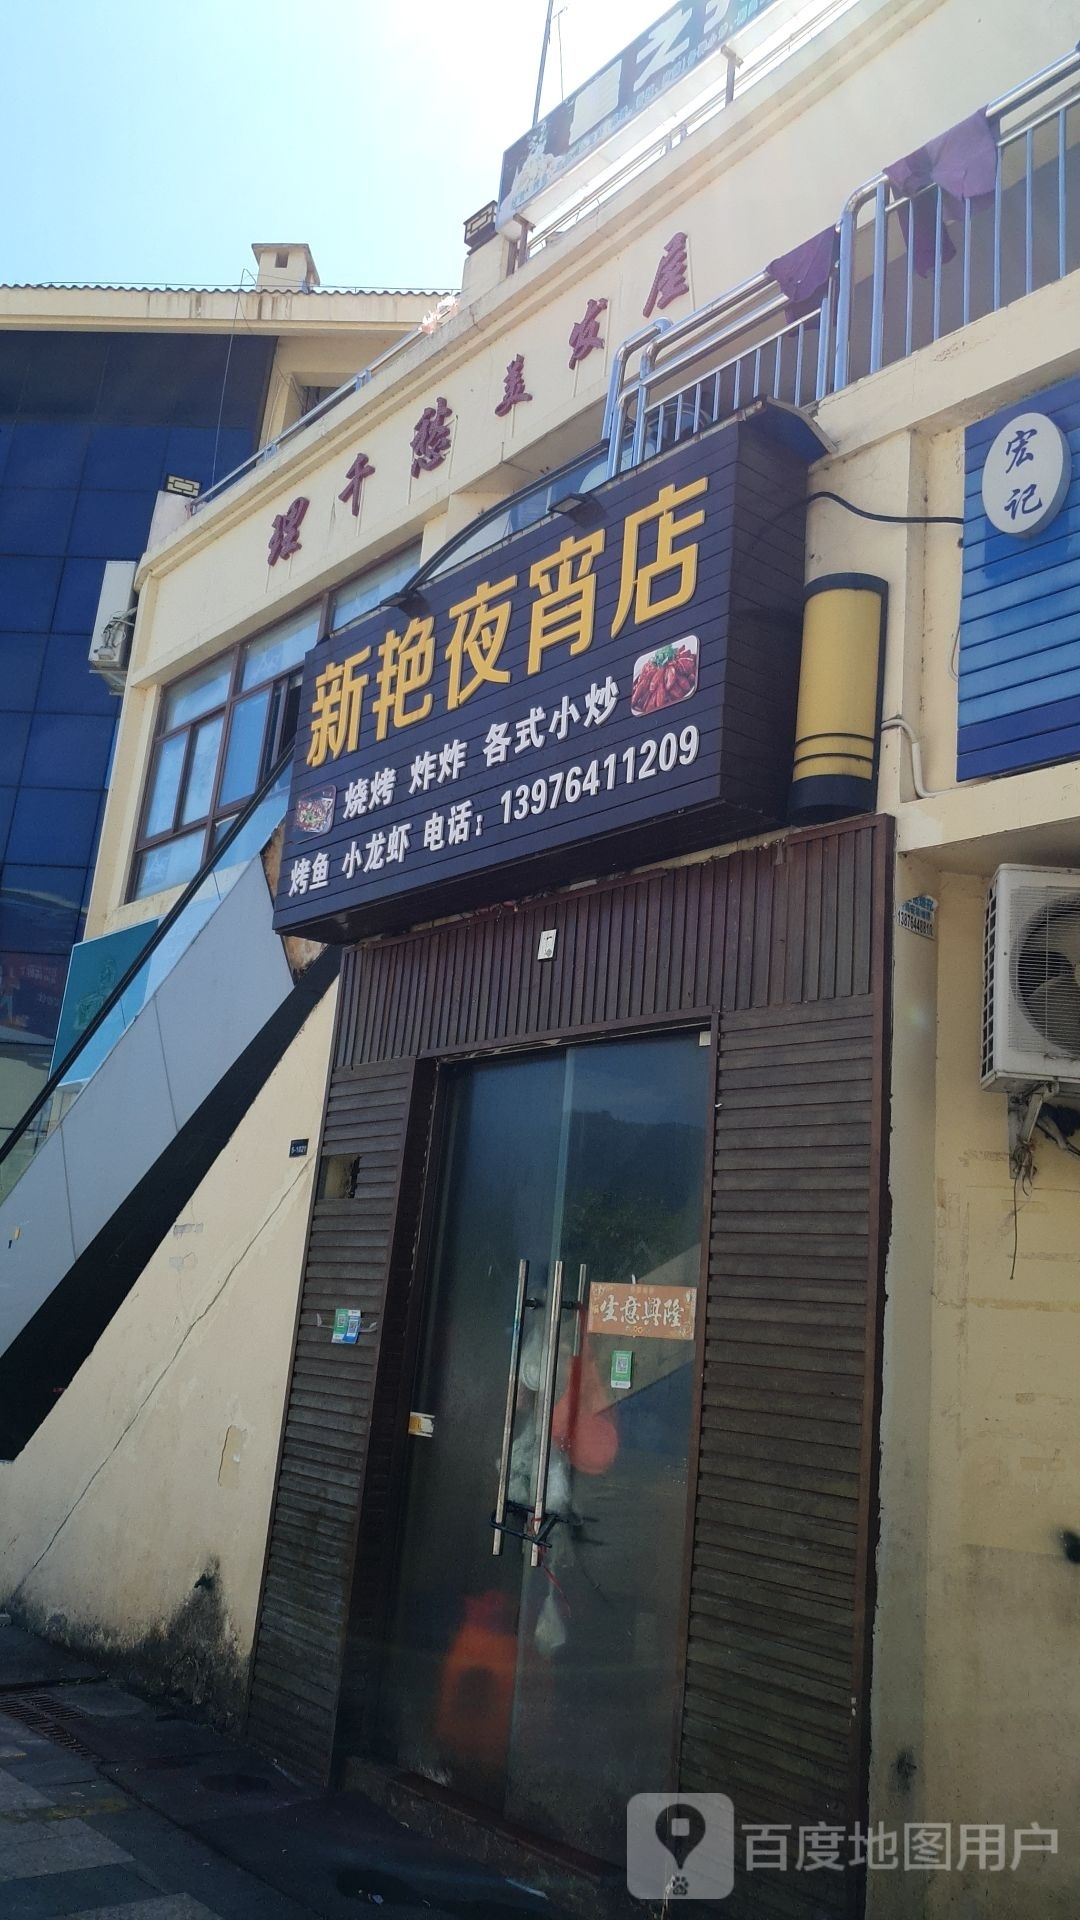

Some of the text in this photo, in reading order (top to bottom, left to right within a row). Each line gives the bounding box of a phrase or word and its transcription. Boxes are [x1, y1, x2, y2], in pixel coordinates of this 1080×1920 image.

[1004, 428, 1042, 520] 宏记
[306, 477, 708, 768] 新艳夜宵店
[288, 851, 330, 898] 烤鱼
[342, 823, 410, 880] 小龙虾
[500, 724, 700, 826] 13976411209
[342, 676, 618, 820] 烧烤 炸炸 各式小炒
